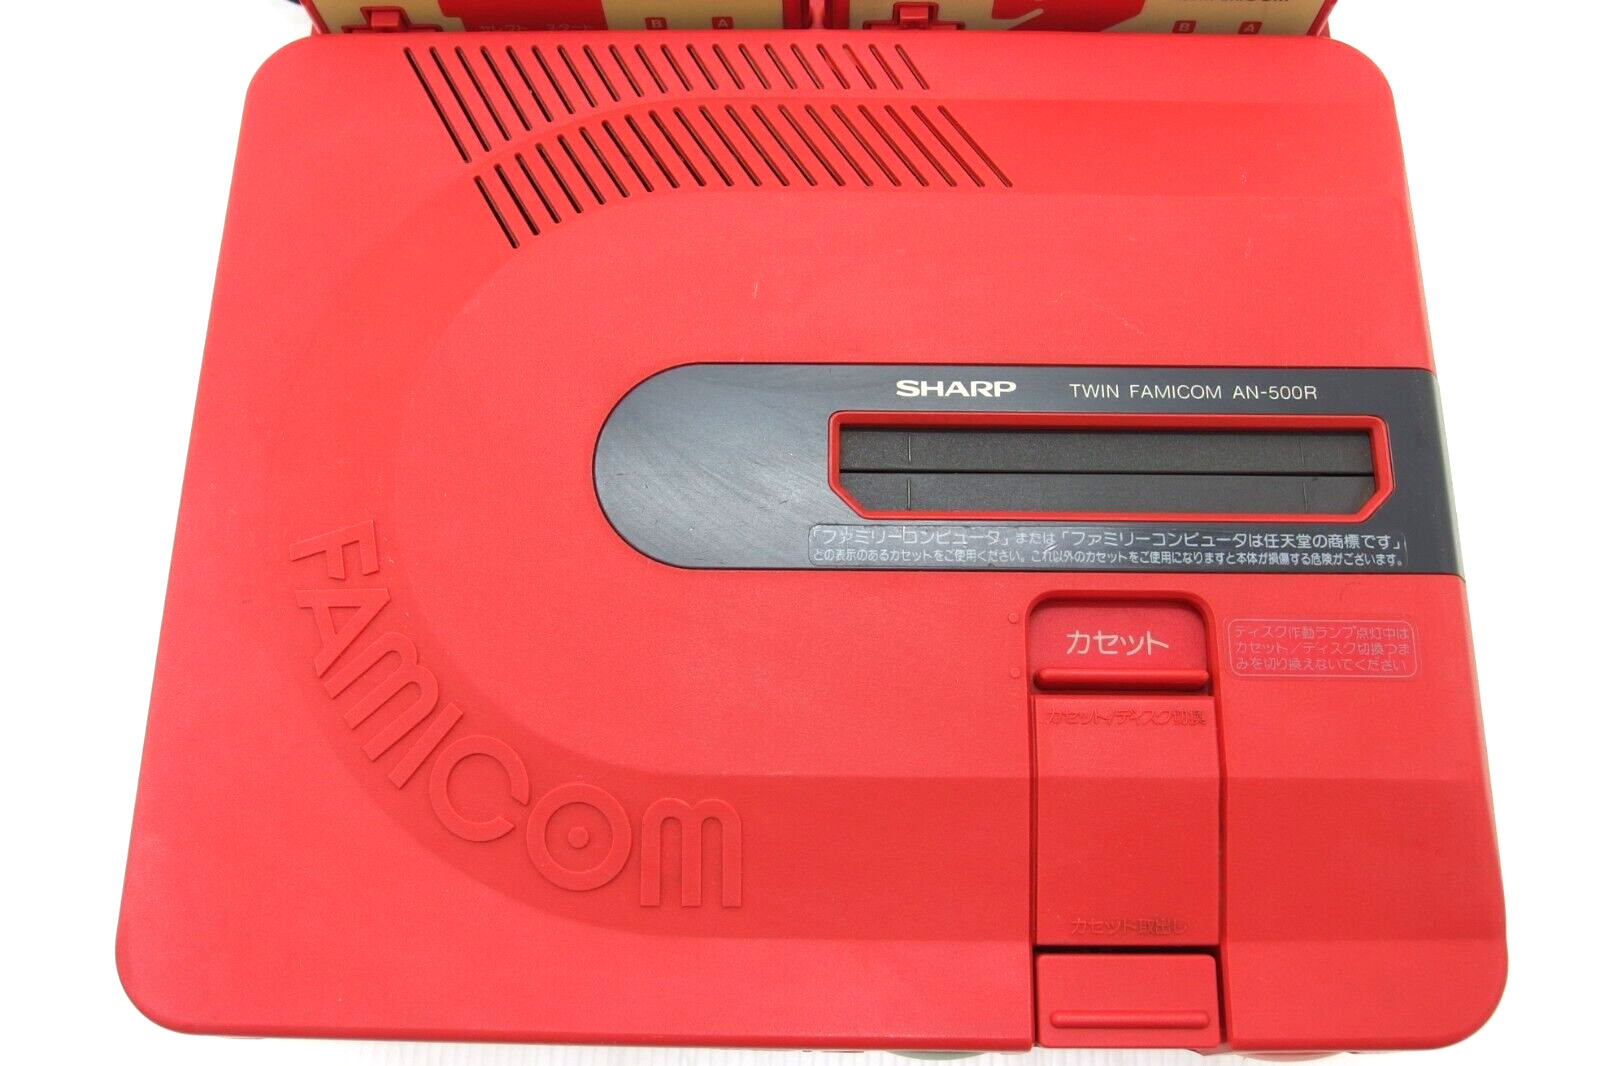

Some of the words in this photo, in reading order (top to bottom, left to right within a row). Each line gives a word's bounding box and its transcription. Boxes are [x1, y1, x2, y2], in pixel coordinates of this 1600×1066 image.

[896, 379, 1017, 398] SHARP
[1069, 384, 1119, 399] TWIN
[1129, 384, 1222, 400] FAMICOM
[1232, 385, 1318, 401] AN-500R
[1066, 629, 1170, 656] カセット
[289, 519, 743, 908] FAMICOM
